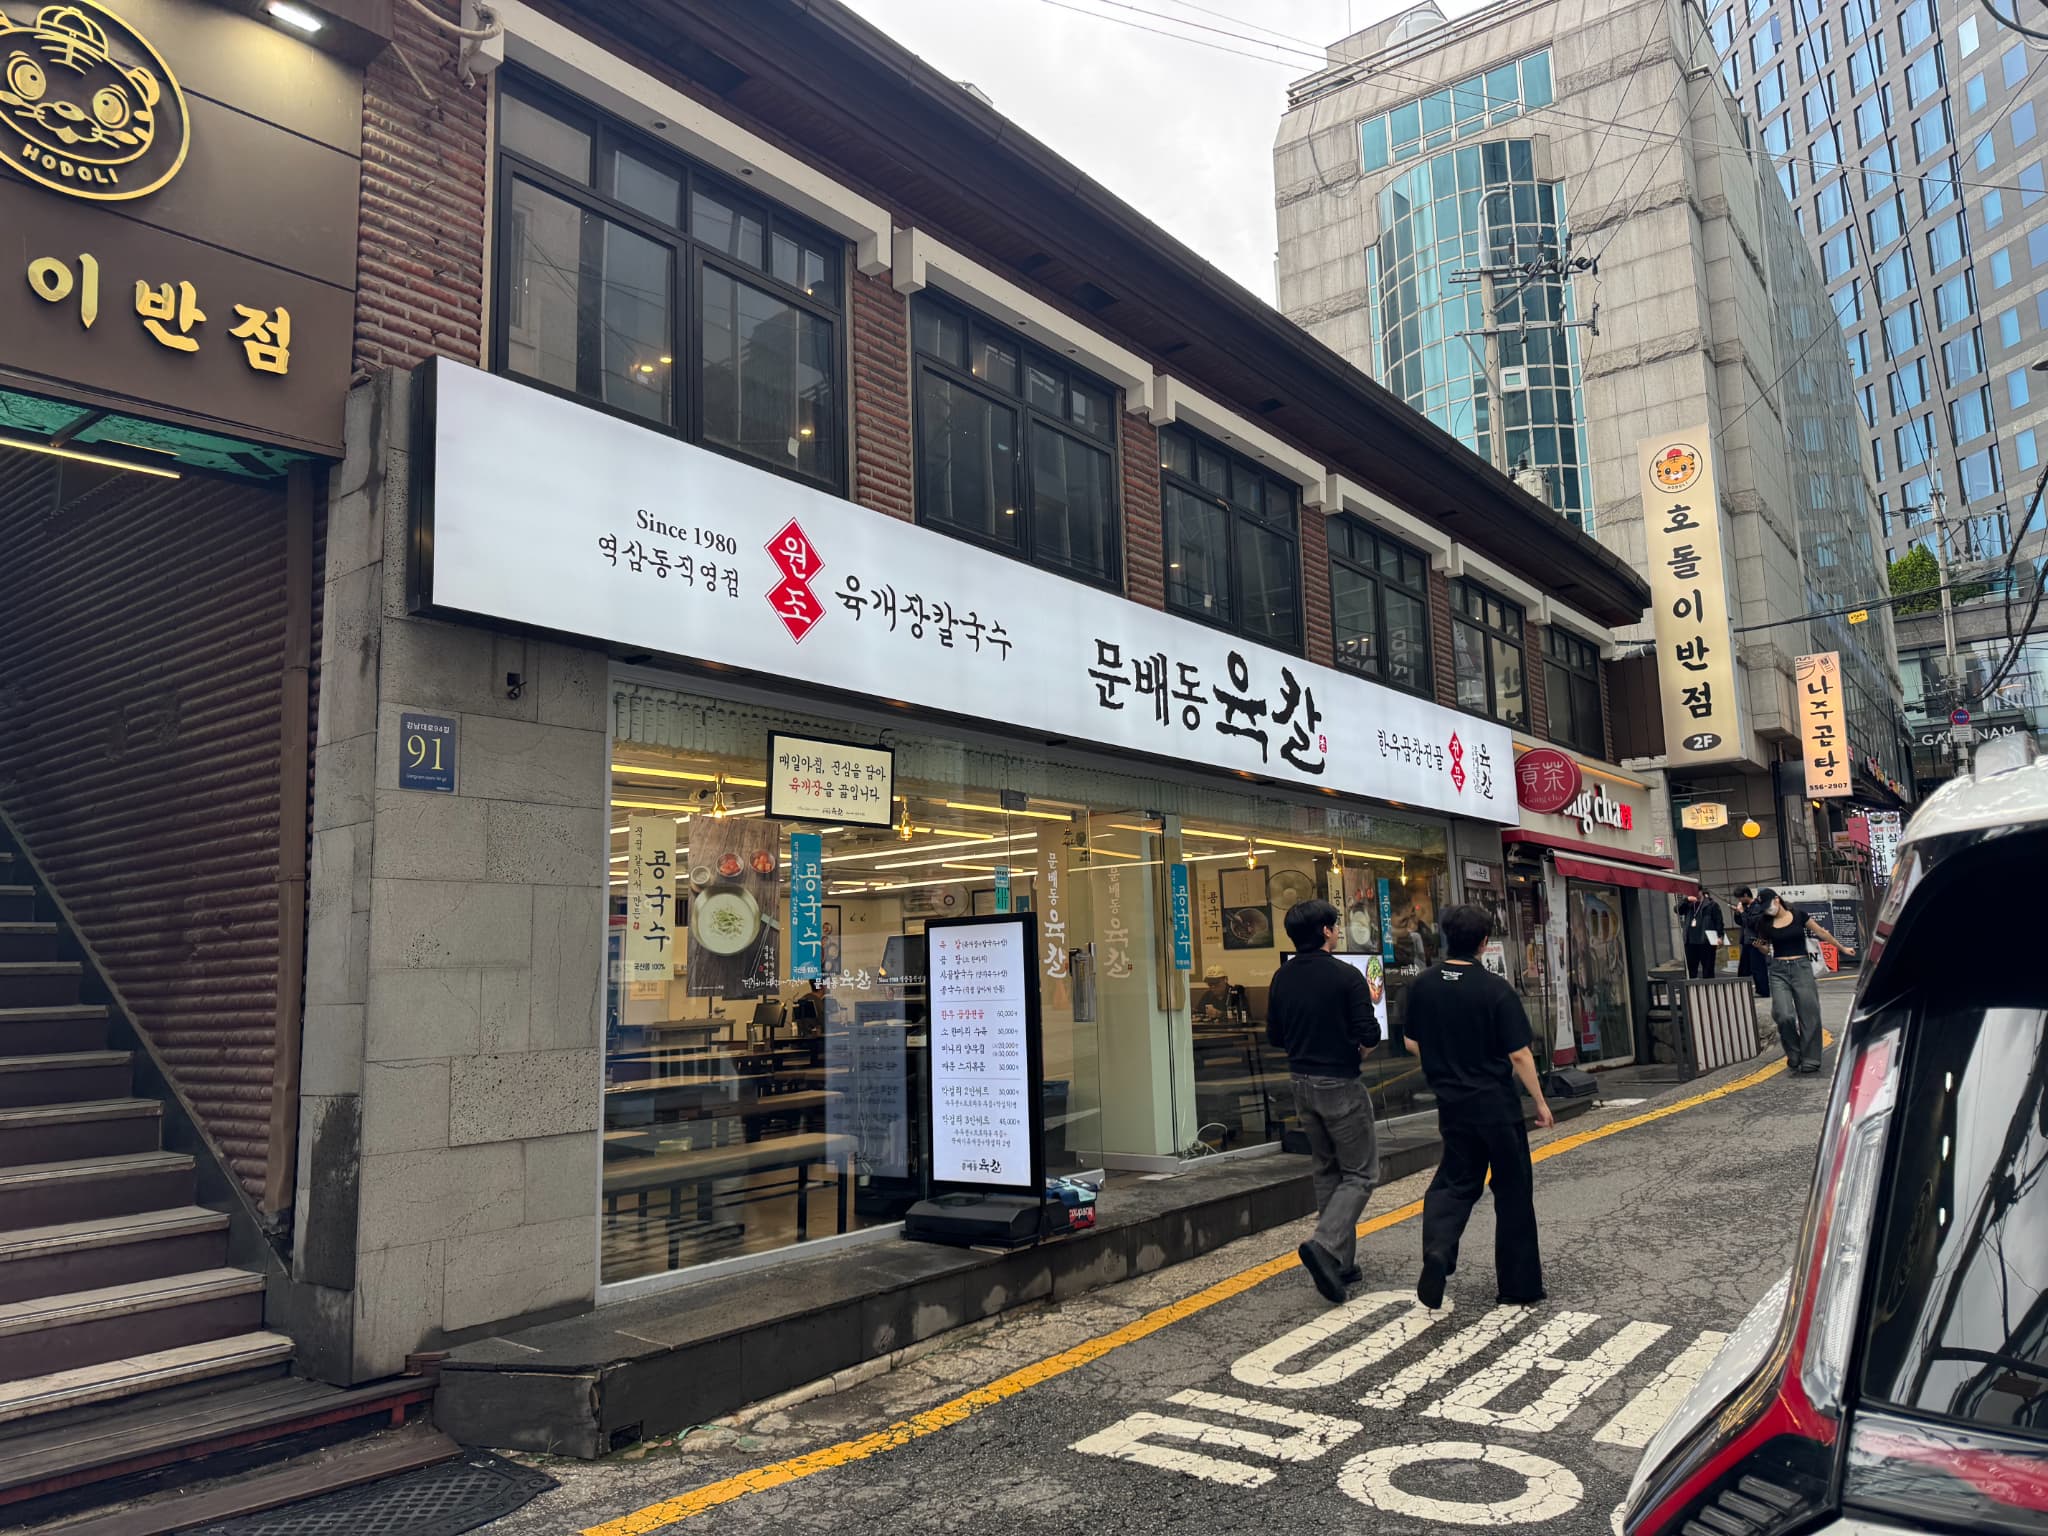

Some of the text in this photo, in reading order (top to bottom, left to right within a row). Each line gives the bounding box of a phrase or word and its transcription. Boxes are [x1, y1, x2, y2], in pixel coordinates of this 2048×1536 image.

[22, 143, 118, 184] HODOLI
[636, 508, 738, 556] Since 1980
[598, 532, 740, 599] 역삼동직영점
[778, 536, 812, 625] 원조
[834, 574, 1014, 661] 육개장칼국수
[1662, 503, 1714, 719] 호돌이반점
[406, 721, 450, 734] 강남대로94길
[1693, 734, 1713, 749] 2F
[1807, 674, 1841, 778] 나주곰탕
[407, 734, 444, 770] 91
[1376, 728, 1444, 771] 한우곱창전골
[1451, 740, 1463, 787] 전문
[789, 776, 834, 798] 육개장을
[831, 760, 862, 779] 진심을
[866, 764, 886, 782] 담아
[1517, 760, 1566, 794] 貢茶
[1809, 782, 1848, 791] 556-2907
[643, 850, 672, 953] 콩국수
[799, 863, 822, 959] 콩국수
[1043, 852, 1067, 978] 문배동 육칼
[839, 969, 872, 990] 육칼
[942, 1086, 962, 1097] 막걸리
[942, 1114, 962, 1126] 막걸리
[979, 1158, 1002, 1174] 육칼
